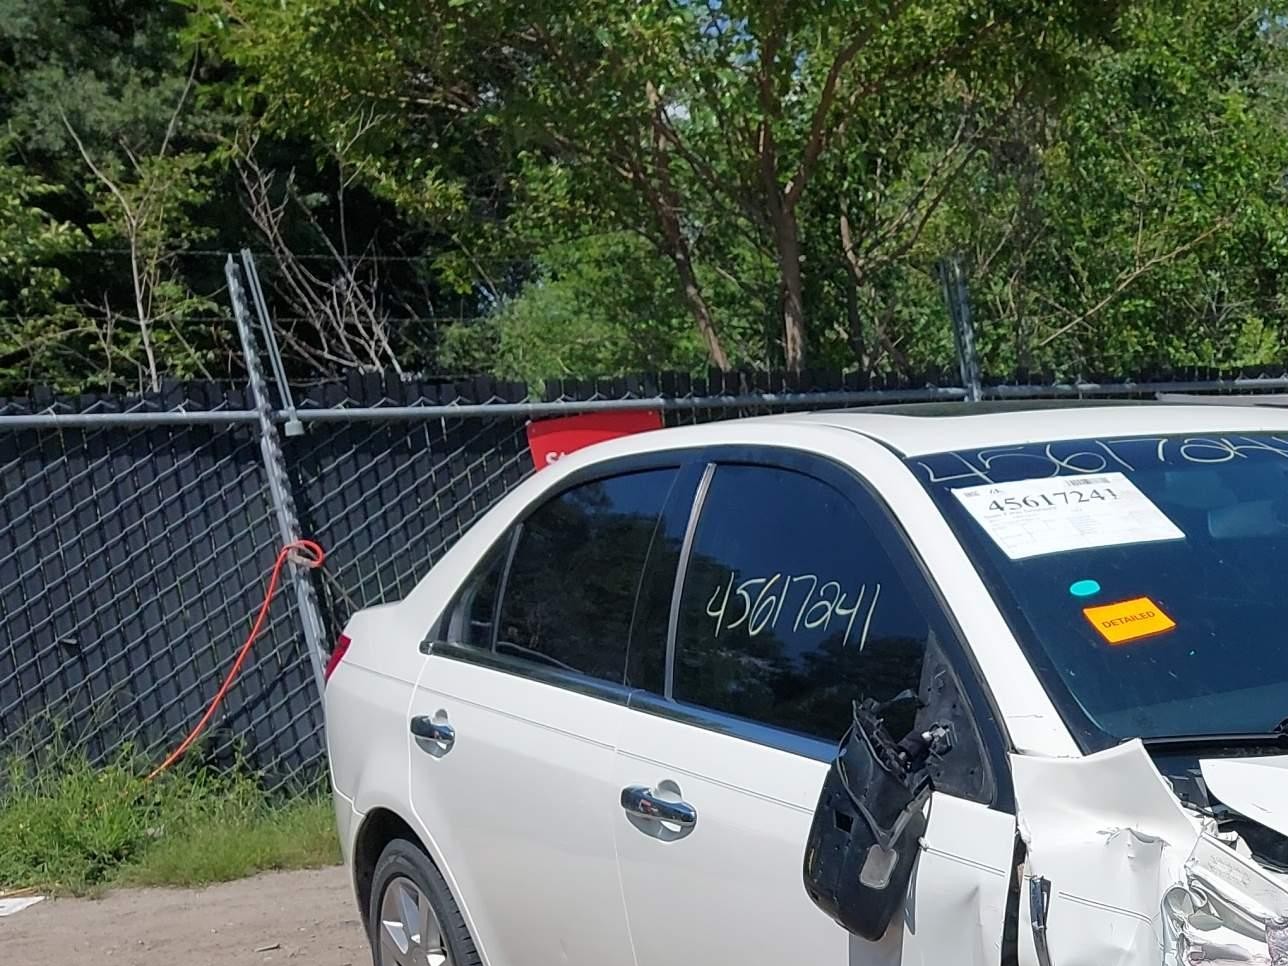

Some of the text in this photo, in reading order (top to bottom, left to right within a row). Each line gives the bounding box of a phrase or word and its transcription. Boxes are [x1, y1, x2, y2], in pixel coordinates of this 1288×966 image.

[988, 487, 1119, 512] 45617241
[706, 571, 881, 652] 45617241
[1102, 610, 1156, 629] DETAILED
